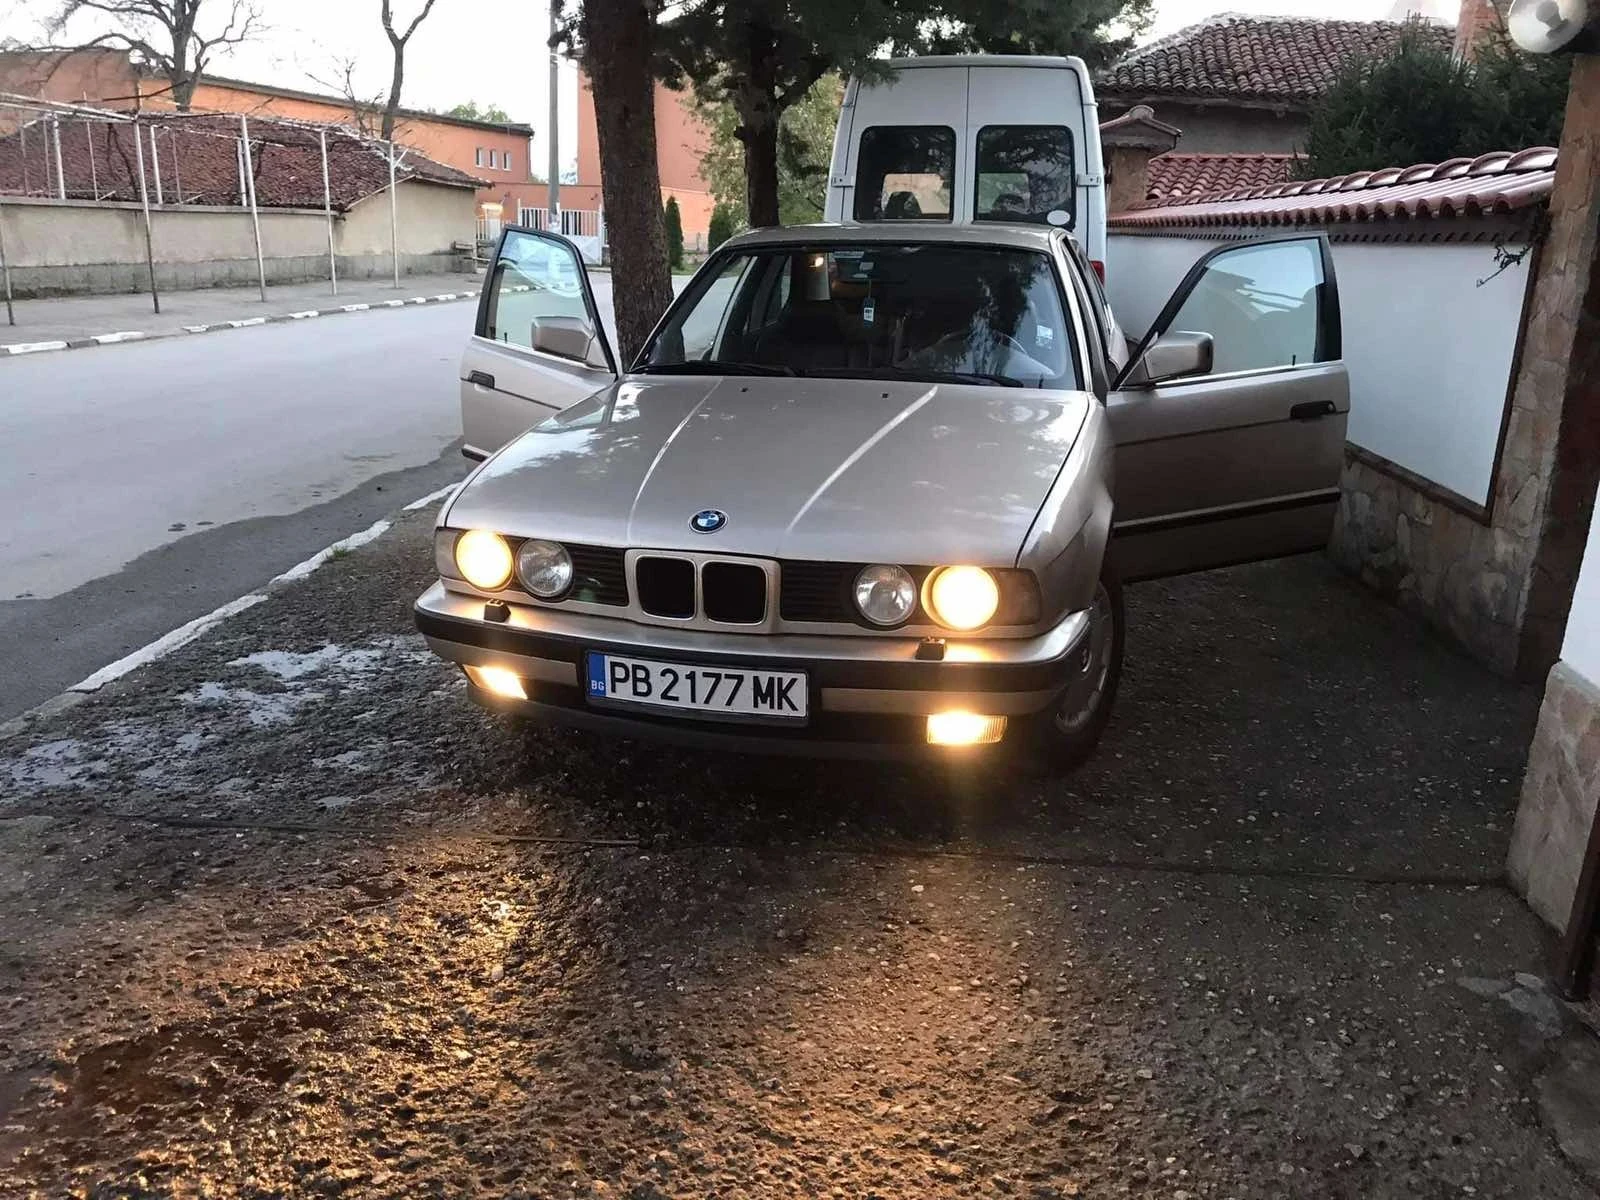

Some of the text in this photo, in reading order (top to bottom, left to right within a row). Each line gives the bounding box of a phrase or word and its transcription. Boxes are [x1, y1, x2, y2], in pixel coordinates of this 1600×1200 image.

[591, 680, 604, 690] BG
[610, 661, 798, 711] PB 2177 MK
